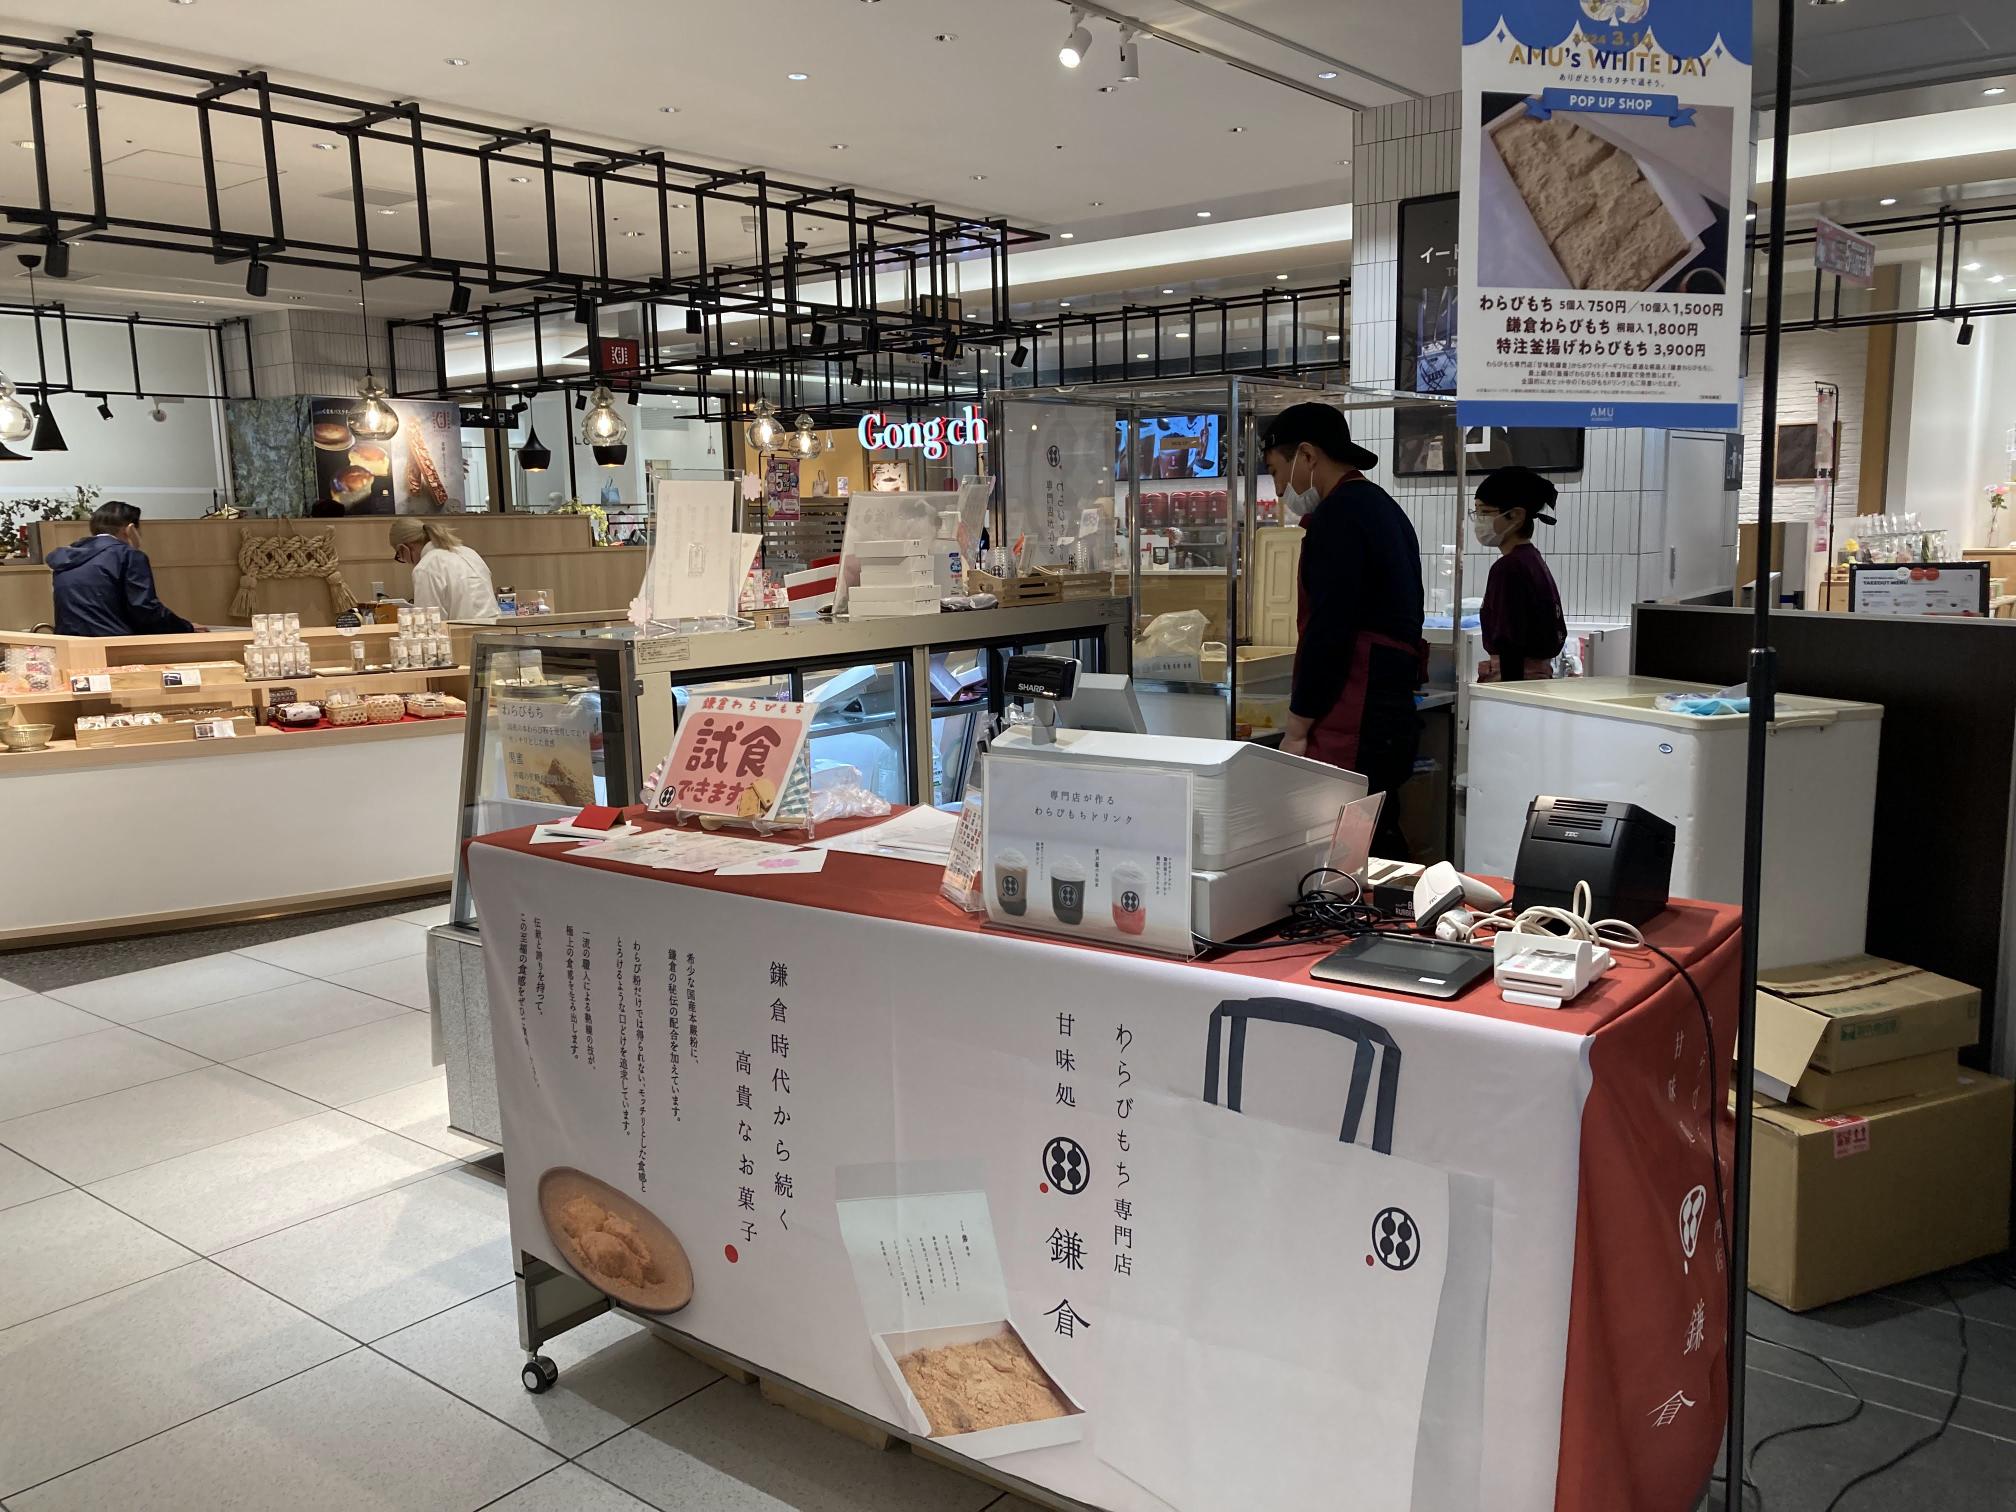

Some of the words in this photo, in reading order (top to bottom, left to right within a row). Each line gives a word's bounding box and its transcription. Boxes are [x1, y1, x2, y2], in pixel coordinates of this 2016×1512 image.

[1508, 44, 1581, 68] AMU's
[1587, 48, 1661, 74] WHITE
[1667, 54, 1712, 77] DAY
[1569, 94, 1596, 107] POP
[1599, 97, 1616, 109] UP
[1618, 98, 1653, 111] SHOP
[1479, 294, 1553, 312] わらびもち
[1559, 300, 1585, 311] 5個入
[1673, 302, 1723, 317] 1,500円
[1506, 316, 1611, 334] 鎌倉わらびもち
[1647, 322, 1699, 336] 1,800円
[1496, 337, 1648, 356] 特注釜揚げわらびもち
[1653, 342, 1706, 357] 3,900円
[1590, 407, 1614, 417] AMU
[858, 413, 947, 460] Gong
[1018, 683, 1045, 693] SHARP
[501, 704, 544, 719] わらびもち
[701, 696, 804, 714] 鎌倉わらびもち
[685, 717, 782, 778] 試食
[677, 776, 745, 806] できます
[1049, 790, 1115, 806] 専門店が作る
[1034, 806, 1133, 825] わらびもちドリンク
[686, 952, 699, 1065] 希少な国産本蕨粉に、
[615, 936, 631, 1136] とろけるような口どけを追求しています。
[668, 948, 681, 1122] 鎌倉の秘伝の配合を加えています。
[1055, 1012, 1076, 1108] 甘味処
[769, 960, 793, 1230] 鎌倉時代から続く
[735, 1050, 758, 1242] 高貴なお菓子
[1113, 1023, 1134, 1277] わらびもち専門店
[1043, 1226, 1091, 1339] 鎌倉
[1646, 1297, 1705, 1428] 鎌倉
